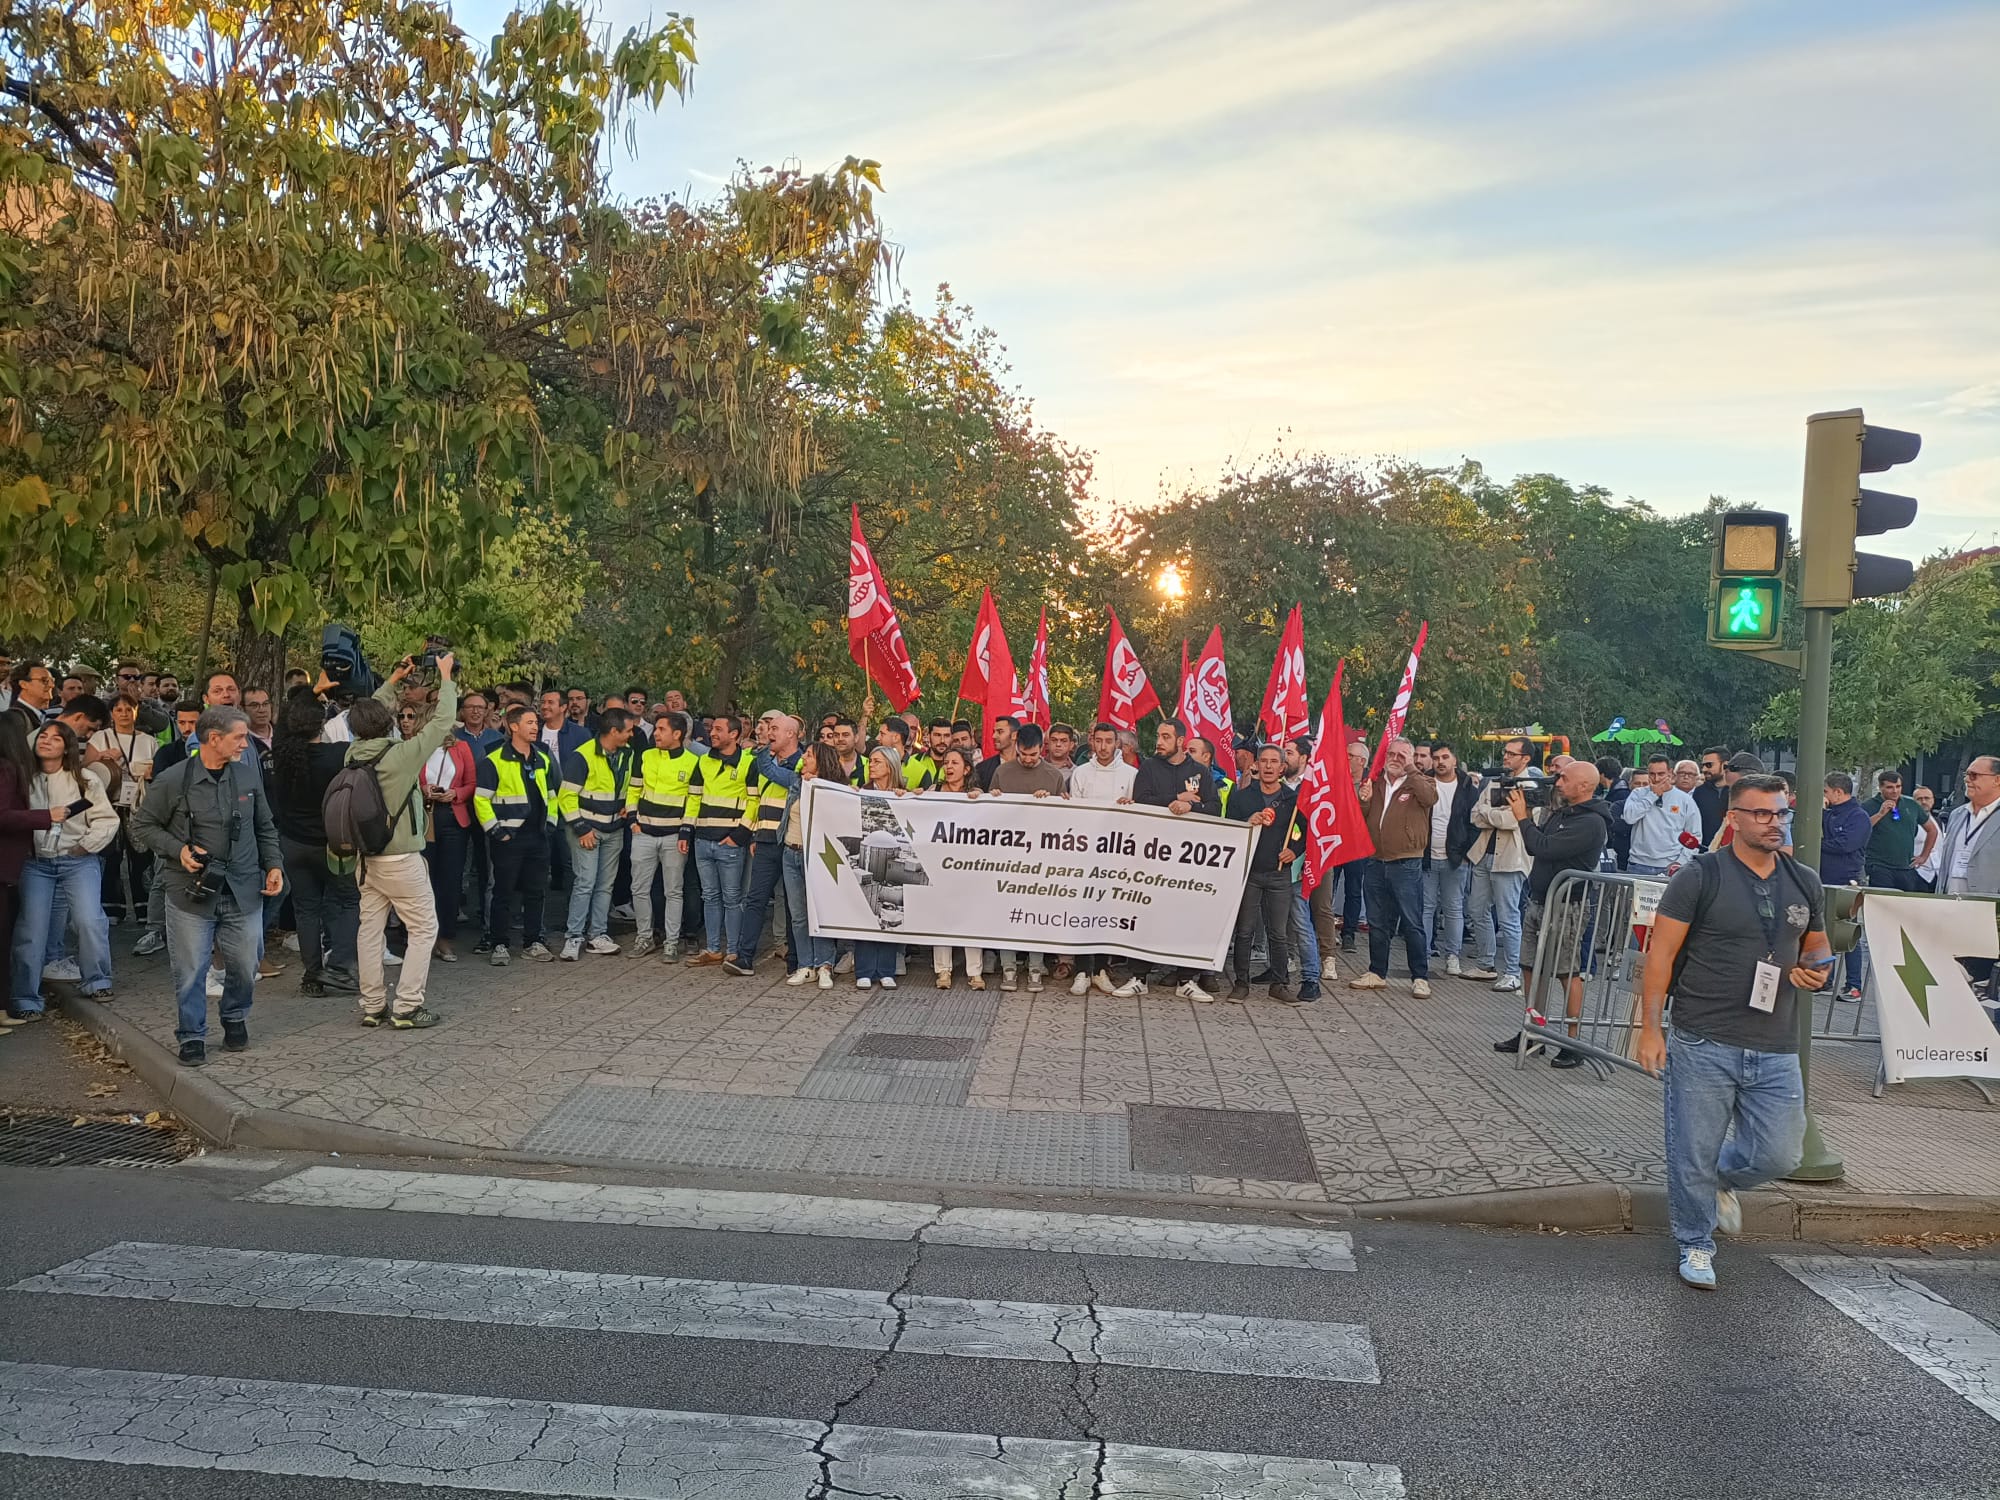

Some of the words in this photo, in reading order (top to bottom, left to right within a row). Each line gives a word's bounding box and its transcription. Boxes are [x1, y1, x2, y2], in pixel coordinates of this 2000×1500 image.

[1310, 759, 1342, 868] FICA
[931, 821, 1032, 853] Almaraz,
[1040, 828, 1088, 852] más
[1096, 831, 1136, 856] allá
[1143, 837, 1172, 861] de
[1178, 841, 1236, 869] 2027
[942, 857, 1042, 875] Continuidad
[1045, 866, 1084, 878] para
[997, 879, 1077, 898] Vandellós
[1082, 886, 1094, 899] II
[1096, 888, 1107, 902] y
[1111, 886, 1152, 905] Trillo
[1009, 908, 1138, 931] #nuclearessí
[1896, 1045, 1989, 1062] nuclearessí
